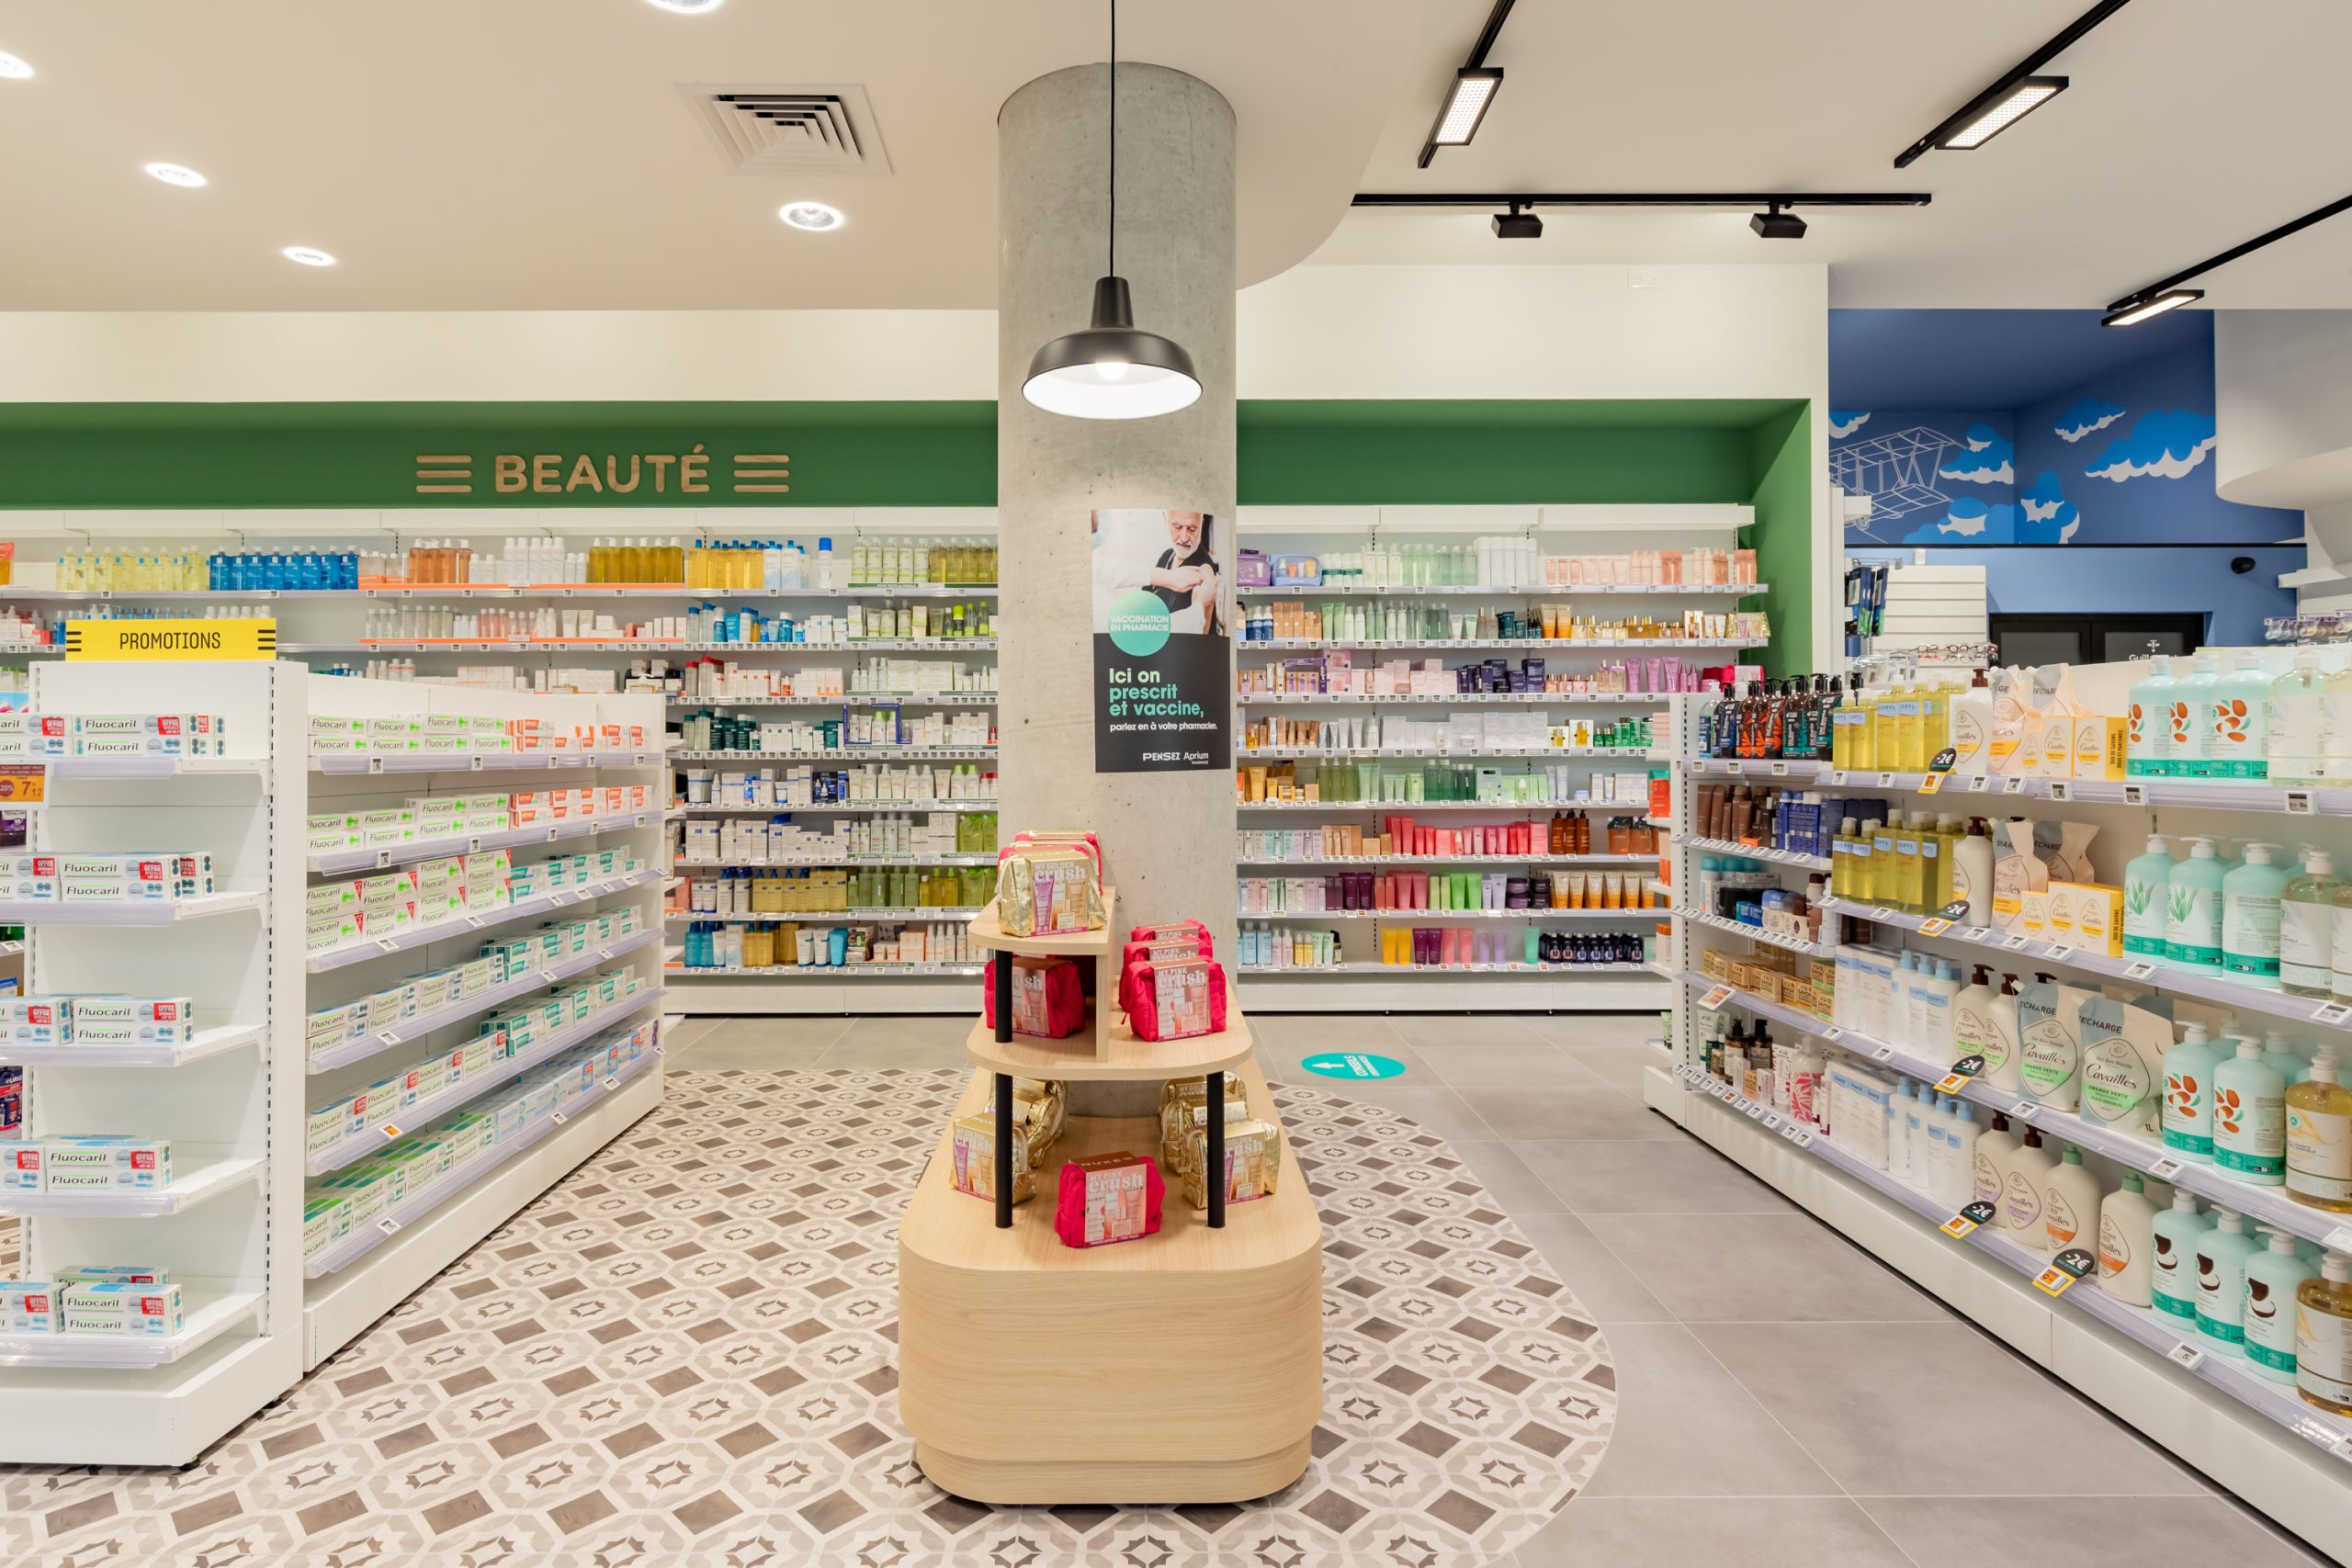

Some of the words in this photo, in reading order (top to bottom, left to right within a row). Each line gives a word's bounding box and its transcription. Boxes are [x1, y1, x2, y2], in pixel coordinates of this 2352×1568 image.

[495, 444, 710, 493] BEAUTÉ
[1123, 624, 1169, 632] PHARMACIE
[119, 631, 220, 650] PROMOTIONS
[1109, 668, 1132, 683] Ici
[1137, 671, 1160, 683] on
[1109, 683, 1178, 703] prescrit
[1109, 701, 1128, 716] et
[1134, 700, 1204, 717] vaccine,
[0, 720, 20, 728] aril
[85, 719, 137, 728] Fluocaril
[311, 719, 346, 728] Fluocaril
[374, 722, 404, 731] Fluocaril
[427, 717, 456, 726] Fluocaril
[1110, 723, 1136, 732] parlez
[1150, 722, 1157, 730] à
[1159, 722, 1178, 730] votre
[88, 742, 139, 751] Fluocaril
[313, 740, 349, 749] Fluocaril
[373, 741, 404, 750] Fluocaril
[424, 739, 454, 748] Fluocaril
[1143, 752, 1181, 761] PENSEZ
[1183, 751, 1209, 761] Aprium
[1937, 753, 1954, 764] -2€
[422, 803, 453, 813] Fluocaril
[364, 813, 397, 823] Fluocaril
[420, 824, 451, 834] Fluocaril
[369, 832, 400, 842] Fluocaril
[310, 838, 344, 849] Fluocaril
[469, 854, 495, 864] Fluocaril
[64, 863, 118, 873] Fluocaril
[421, 862, 447, 873] Fluocaril
[469, 870, 494, 880] Fluocaril
[1034, 866, 1087, 883] crush
[363, 877, 395, 888] Fluocaril
[421, 878, 447, 889] Fluocaril
[66, 886, 119, 896] Fluocaril
[307, 888, 341, 900] Fluocaril
[469, 886, 494, 896] Fluocaril
[363, 893, 396, 905] Fluocaril
[421, 895, 447, 905] Fluocaril
[366, 909, 395, 921] Fluocaril
[1947, 904, 1966, 916] -2€
[421, 911, 447, 922] Fluocaril
[366, 925, 395, 937] Fluocaril
[1013, 976, 1044, 991] ush
[1158, 970, 1206, 987] crush
[375, 995, 399, 1009] Fluocaril
[78, 1007, 130, 1016] Fluocaril
[2019, 1000, 2057, 1016] ECHARGE
[311, 1014, 345, 1030] Fluocaril
[370, 1014, 397, 1029] Fluocaril
[78, 1030, 130, 1039] Fluocaril
[312, 1033, 343, 1050] Fluocaril
[1962, 1059, 1980, 1070] -2€
[368, 1086, 396, 1103] Fluocaril
[2109, 1090, 2129, 1100] VERTE
[368, 1104, 396, 1122] Fluocaril
[310, 1111, 342, 1132] Fluocaril
[309, 1132, 341, 1152] Fluocaril
[51, 1152, 107, 1162] Fluocaril
[52, 1175, 108, 1185] Fluocaril
[1088, 1172, 1143, 1192] crush
[1972, 1204, 1993, 1218] -2€
[303, 1217, 328, 1236] ocaril
[303, 1237, 326, 1257] ocaril
[2065, 1253, 2091, 1269] -2€
[67, 1297, 119, 1307] Fluocaril
[70, 1319, 121, 1329] Fluocaril
